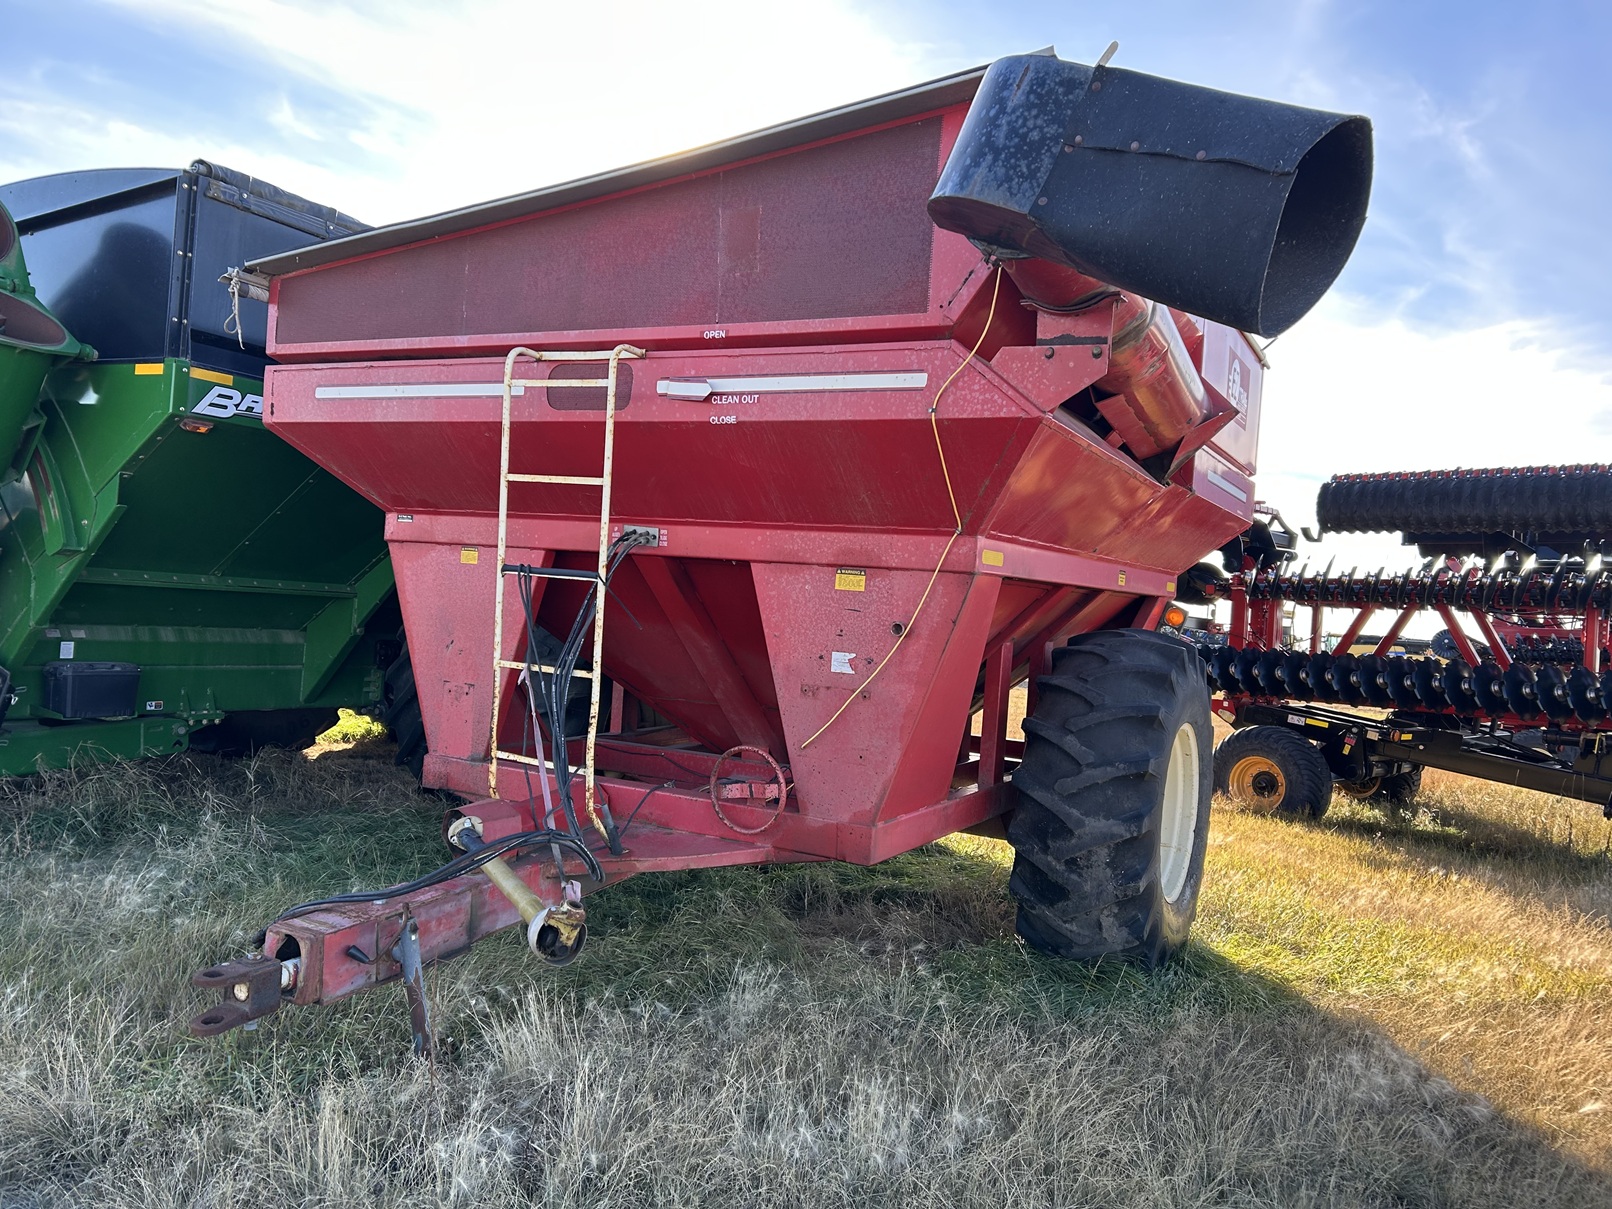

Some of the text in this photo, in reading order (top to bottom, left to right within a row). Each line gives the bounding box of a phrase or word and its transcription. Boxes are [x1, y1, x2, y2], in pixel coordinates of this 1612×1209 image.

[703, 330, 726, 339] OPEN
[711, 394, 759, 404] CLEAN OUT
[709, 416, 737, 424] CLOSE
